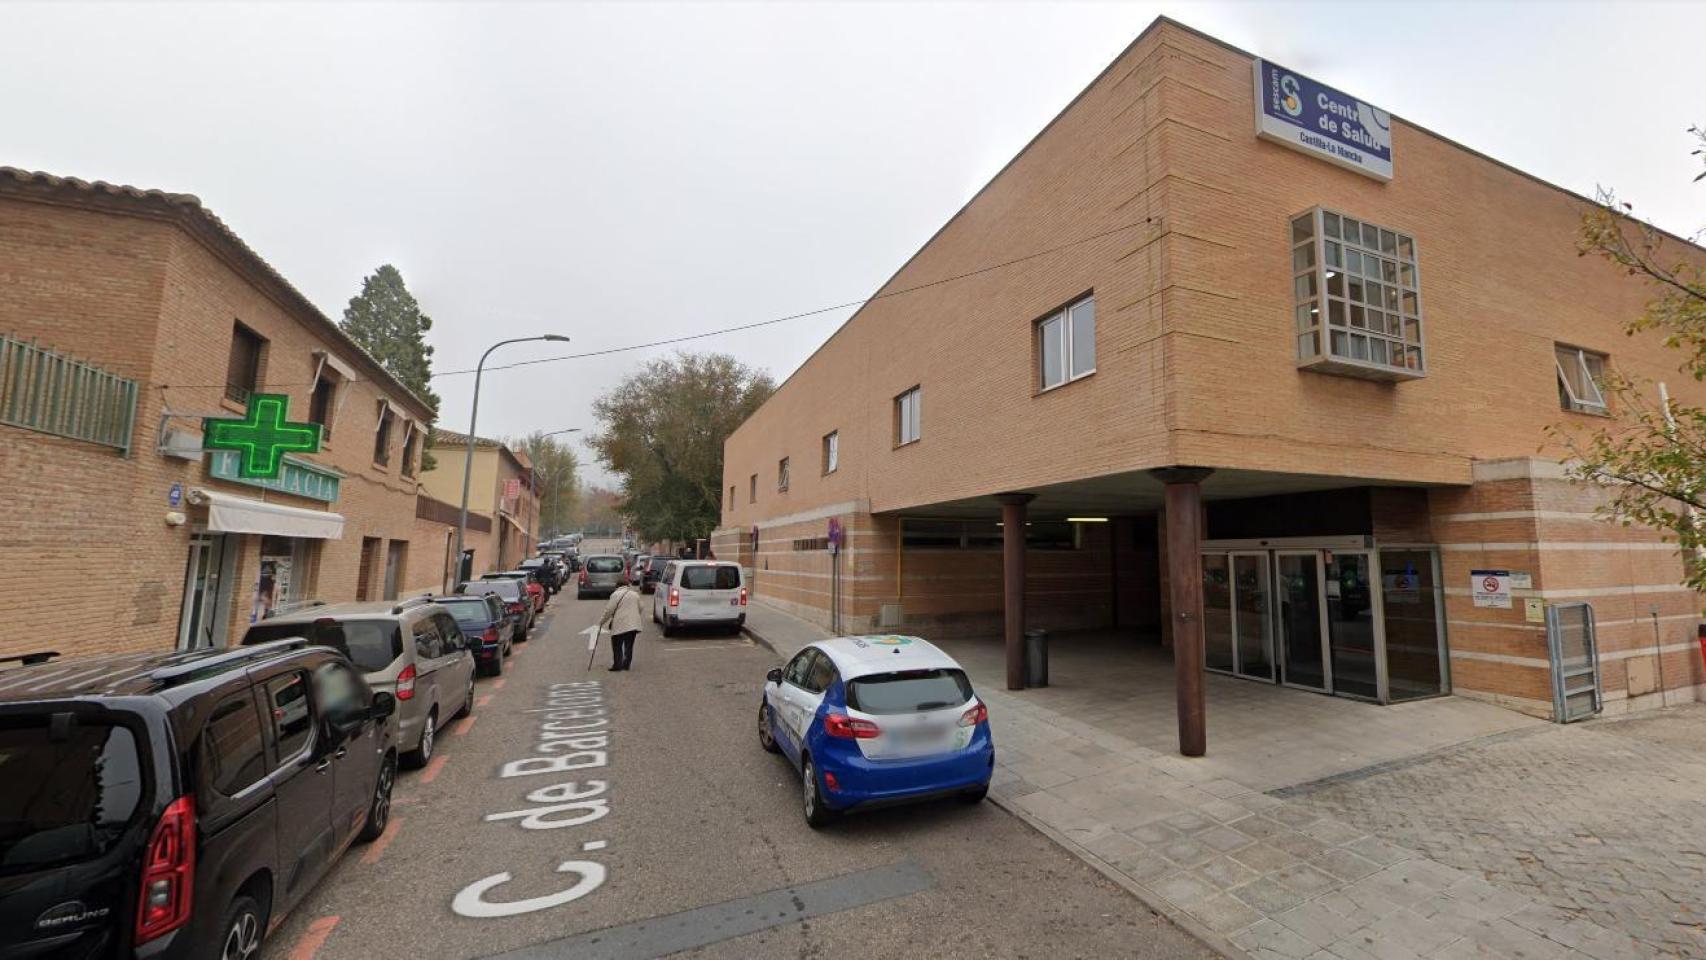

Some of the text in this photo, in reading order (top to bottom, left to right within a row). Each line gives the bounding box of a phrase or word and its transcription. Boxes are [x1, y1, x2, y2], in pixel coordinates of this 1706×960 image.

[1317, 92, 1360, 122] Centr
[1319, 113, 1338, 133] de
[1337, 145, 1363, 164] Mancha
[451, 681, 611, 918] C. de Barcelona
